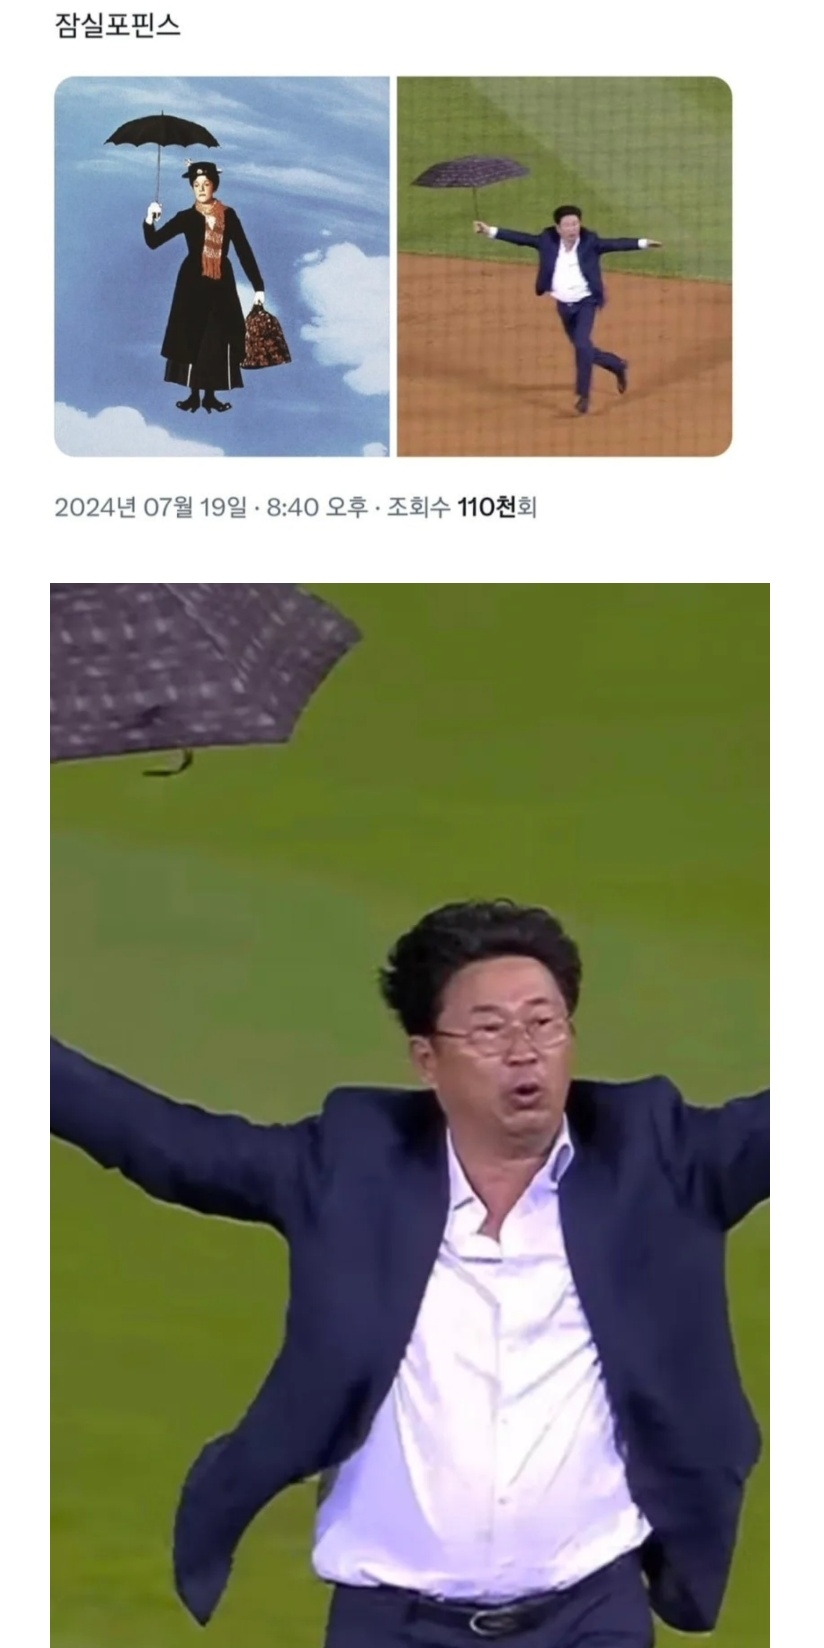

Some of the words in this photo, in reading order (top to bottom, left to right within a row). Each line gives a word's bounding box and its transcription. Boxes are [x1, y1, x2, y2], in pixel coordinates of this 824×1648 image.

[55, 12, 181, 39] 잠실포핀스
[55, 496, 136, 519] 2024년
[144, 496, 192, 519] 07월
[200, 496, 246, 519] 19일
[267, 497, 319, 517] 8:40
[326, 496, 368, 519] 오후
[387, 496, 451, 519] 조회수
[457, 495, 536, 519] 110천회
